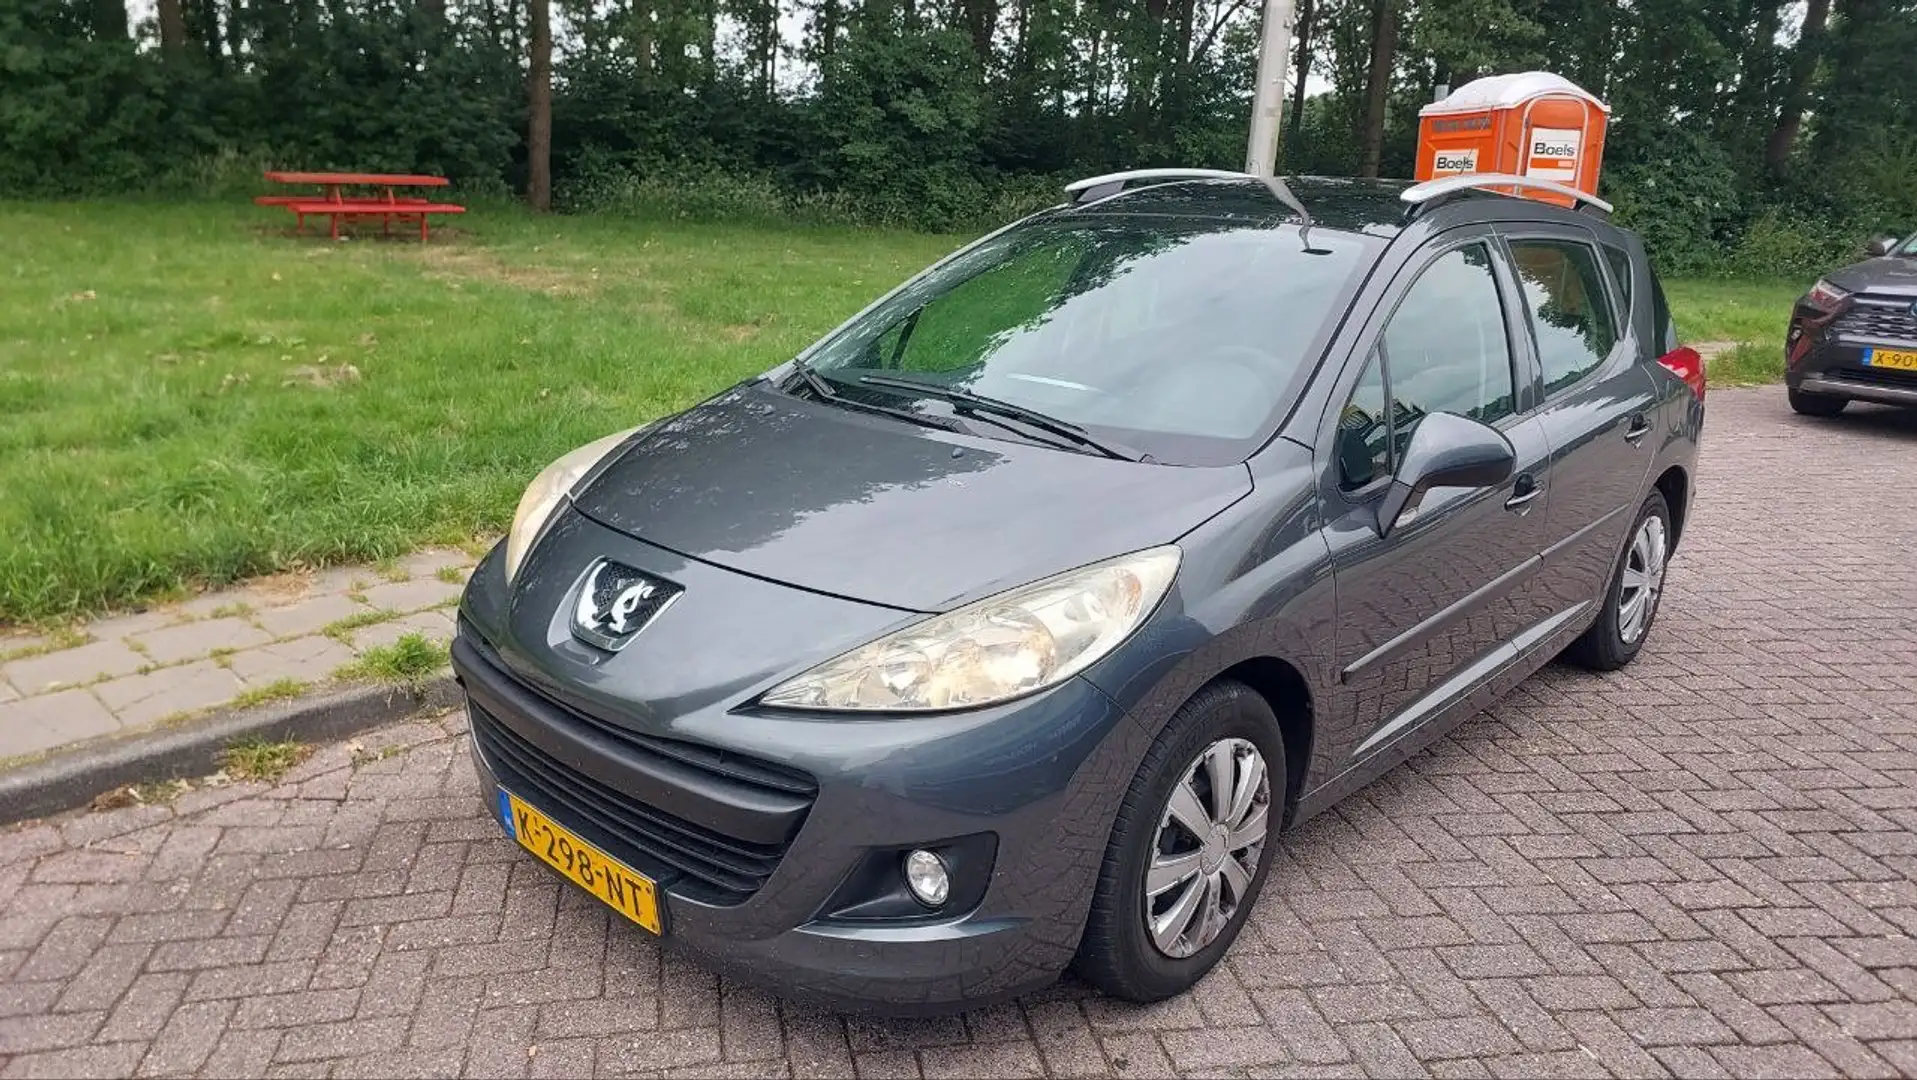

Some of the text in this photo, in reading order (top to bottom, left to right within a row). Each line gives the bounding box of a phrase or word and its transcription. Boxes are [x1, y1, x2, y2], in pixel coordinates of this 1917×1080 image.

[1533, 142, 1575, 157] Boels
[1436, 156, 1474, 169] Boels
[1873, 351, 1917, 368] X-90
[516, 807, 641, 919] K-298-NT
